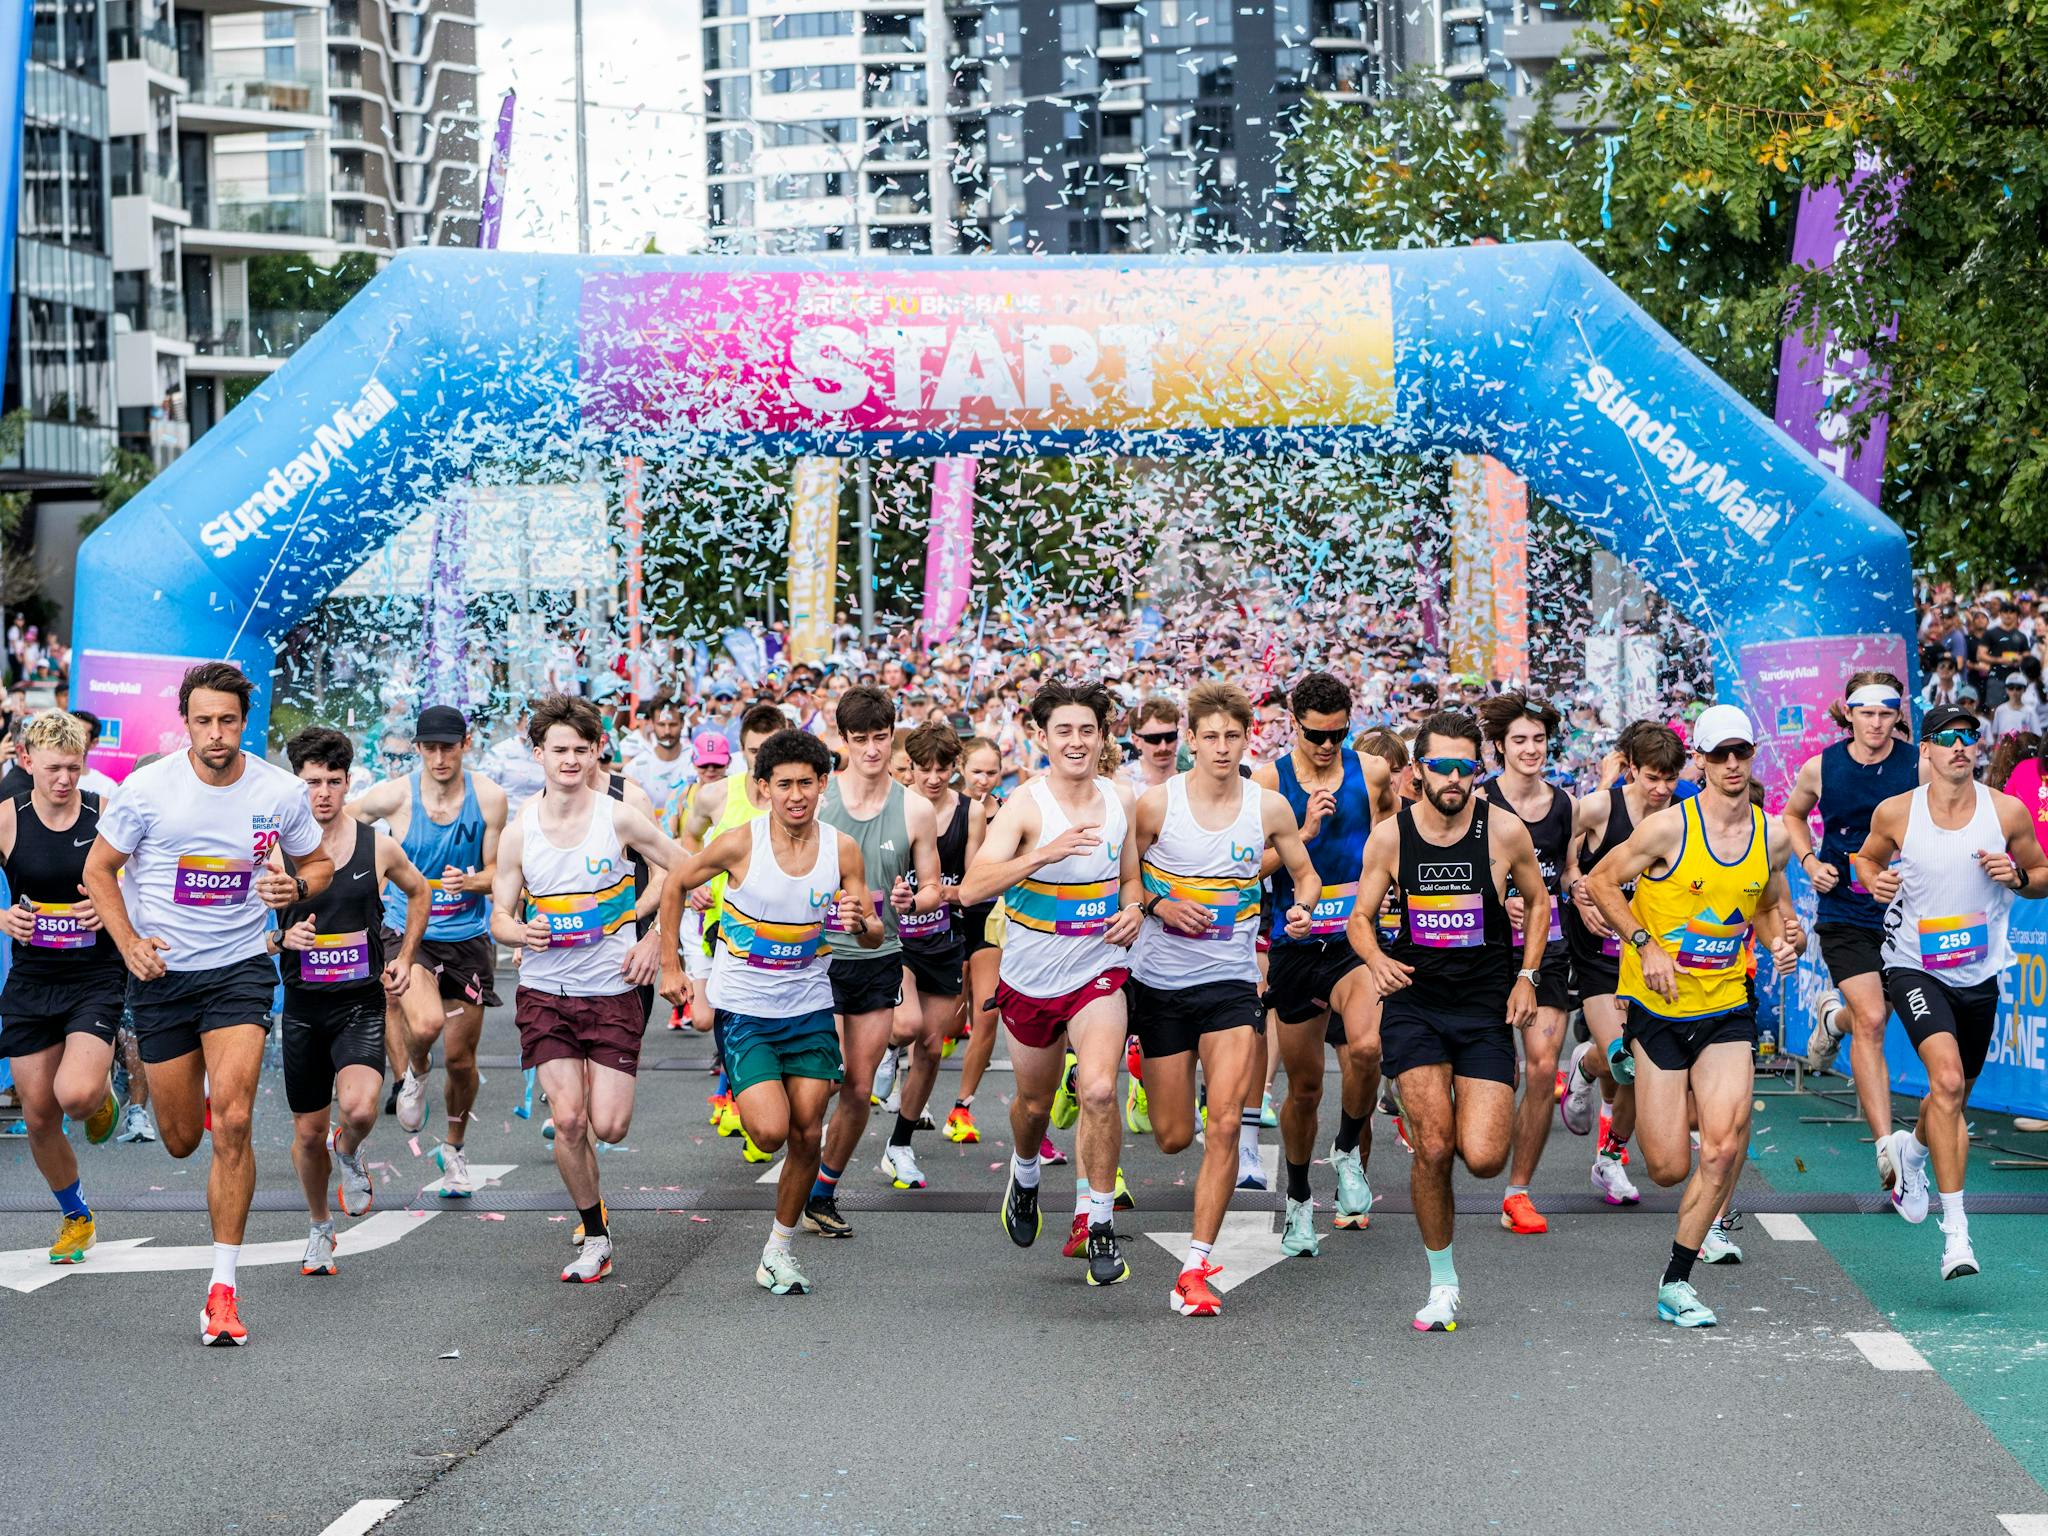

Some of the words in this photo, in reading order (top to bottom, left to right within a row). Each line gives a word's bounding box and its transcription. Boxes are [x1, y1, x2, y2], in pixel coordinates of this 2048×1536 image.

[791, 323, 1178, 411] START
[253, 831, 280, 851] 20
[184, 872, 242, 889] 35024
[1075, 901, 1106, 917] 498
[1313, 901, 1344, 916] 497
[552, 916, 584, 930] 386
[900, 909, 944, 926] 35020
[1416, 912, 1476, 929] 35003
[1694, 938, 1736, 953] 2454
[1938, 931, 1971, 950] 259
[308, 948, 360, 965] 35013
[769, 944, 803, 957] 388
[2017, 953, 2047, 1007] TO
[1906, 987, 1932, 1022] NOX
